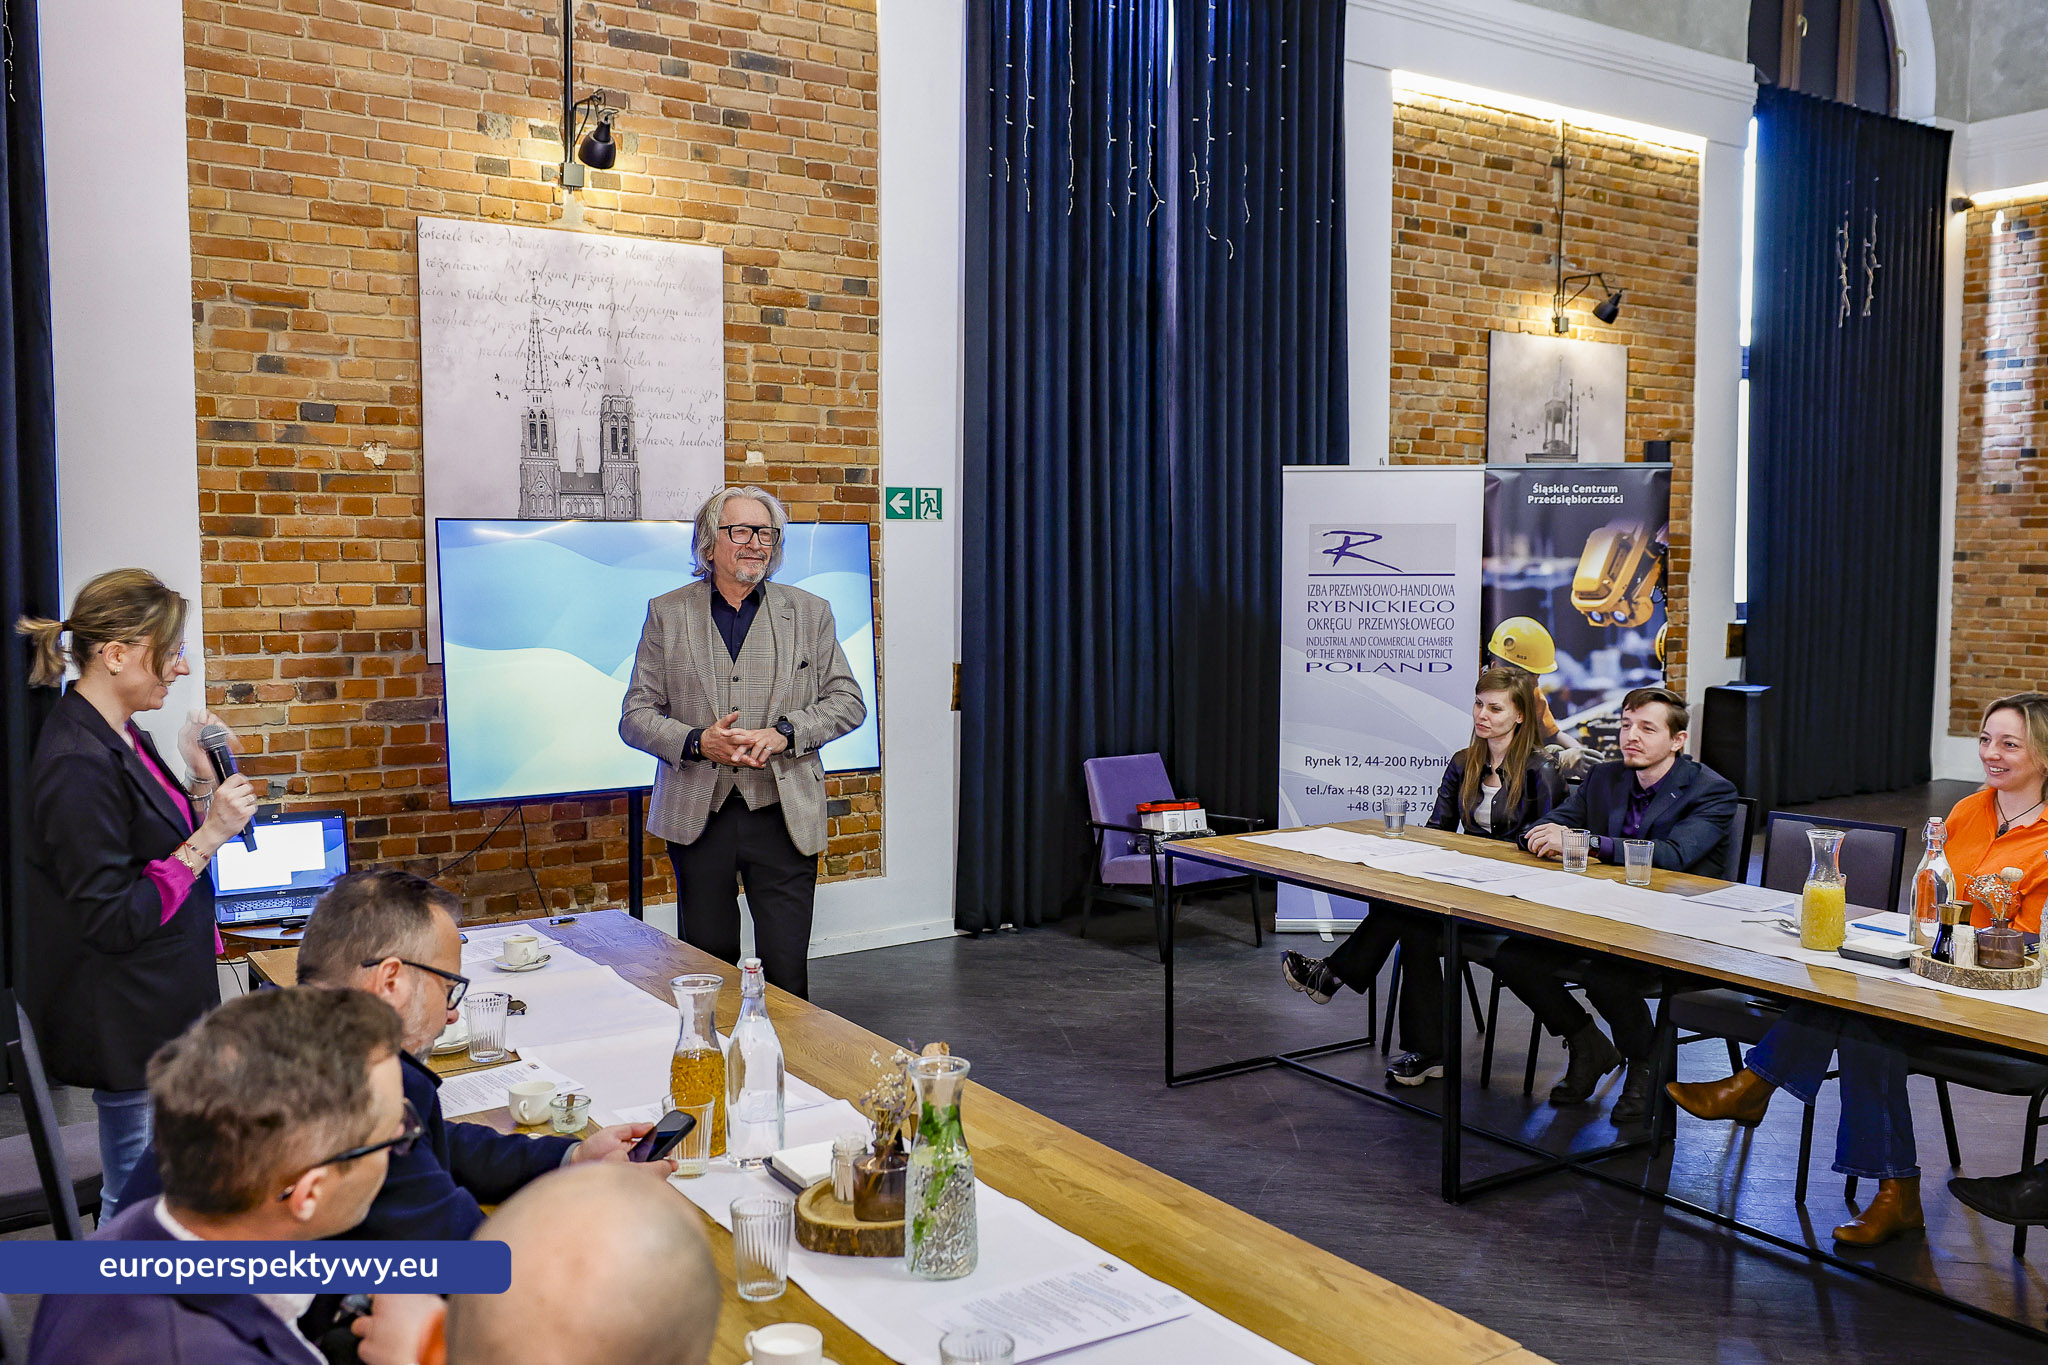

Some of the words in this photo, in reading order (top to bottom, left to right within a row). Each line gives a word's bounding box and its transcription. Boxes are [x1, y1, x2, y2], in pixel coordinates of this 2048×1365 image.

[1532, 483, 1570, 495] Śląskie
[1572, 484, 1618, 494] Centrum
[1527, 494, 1624, 506] Przedsiębiorczości
[1307, 583, 1328, 597] IZBA
[1329, 583, 1455, 597] PRZEMYSŁOWO-HANDLOWA
[1307, 600, 1455, 613] RYBNICKIEGO
[1307, 617, 1352, 633] OKRĘGU
[1358, 617, 1455, 630] PRZEMYSŁOWEGO
[1306, 636, 1348, 647] INDUSTRIAL
[1349, 636, 1367, 647] AND
[1367, 636, 1416, 647] COMMERCIAL
[1417, 636, 1453, 647] CHAMBER
[1306, 648, 1317, 659] OF
[1319, 648, 1335, 659] THE
[1336, 648, 1366, 659] RYBNIK
[1367, 648, 1415, 659] INDUSTRIAL
[1417, 648, 1453, 659] DISTRICT
[1306, 661, 1453, 673] POLAND
[1305, 755, 1341, 769] Rynek
[1345, 755, 1362, 768] 12,
[1364, 756, 1407, 767] 44-200
[1409, 756, 1451, 769] Rybnik
[1305, 785, 1345, 796] tel./fax
[1347, 785, 1370, 796] +48
[1372, 785, 1394, 797] (32)
[1396, 785, 1418, 796] 422
[1421, 785, 1433, 796] 11
[1346, 801, 1369, 812] +48
[1420, 801, 1434, 812] 76
